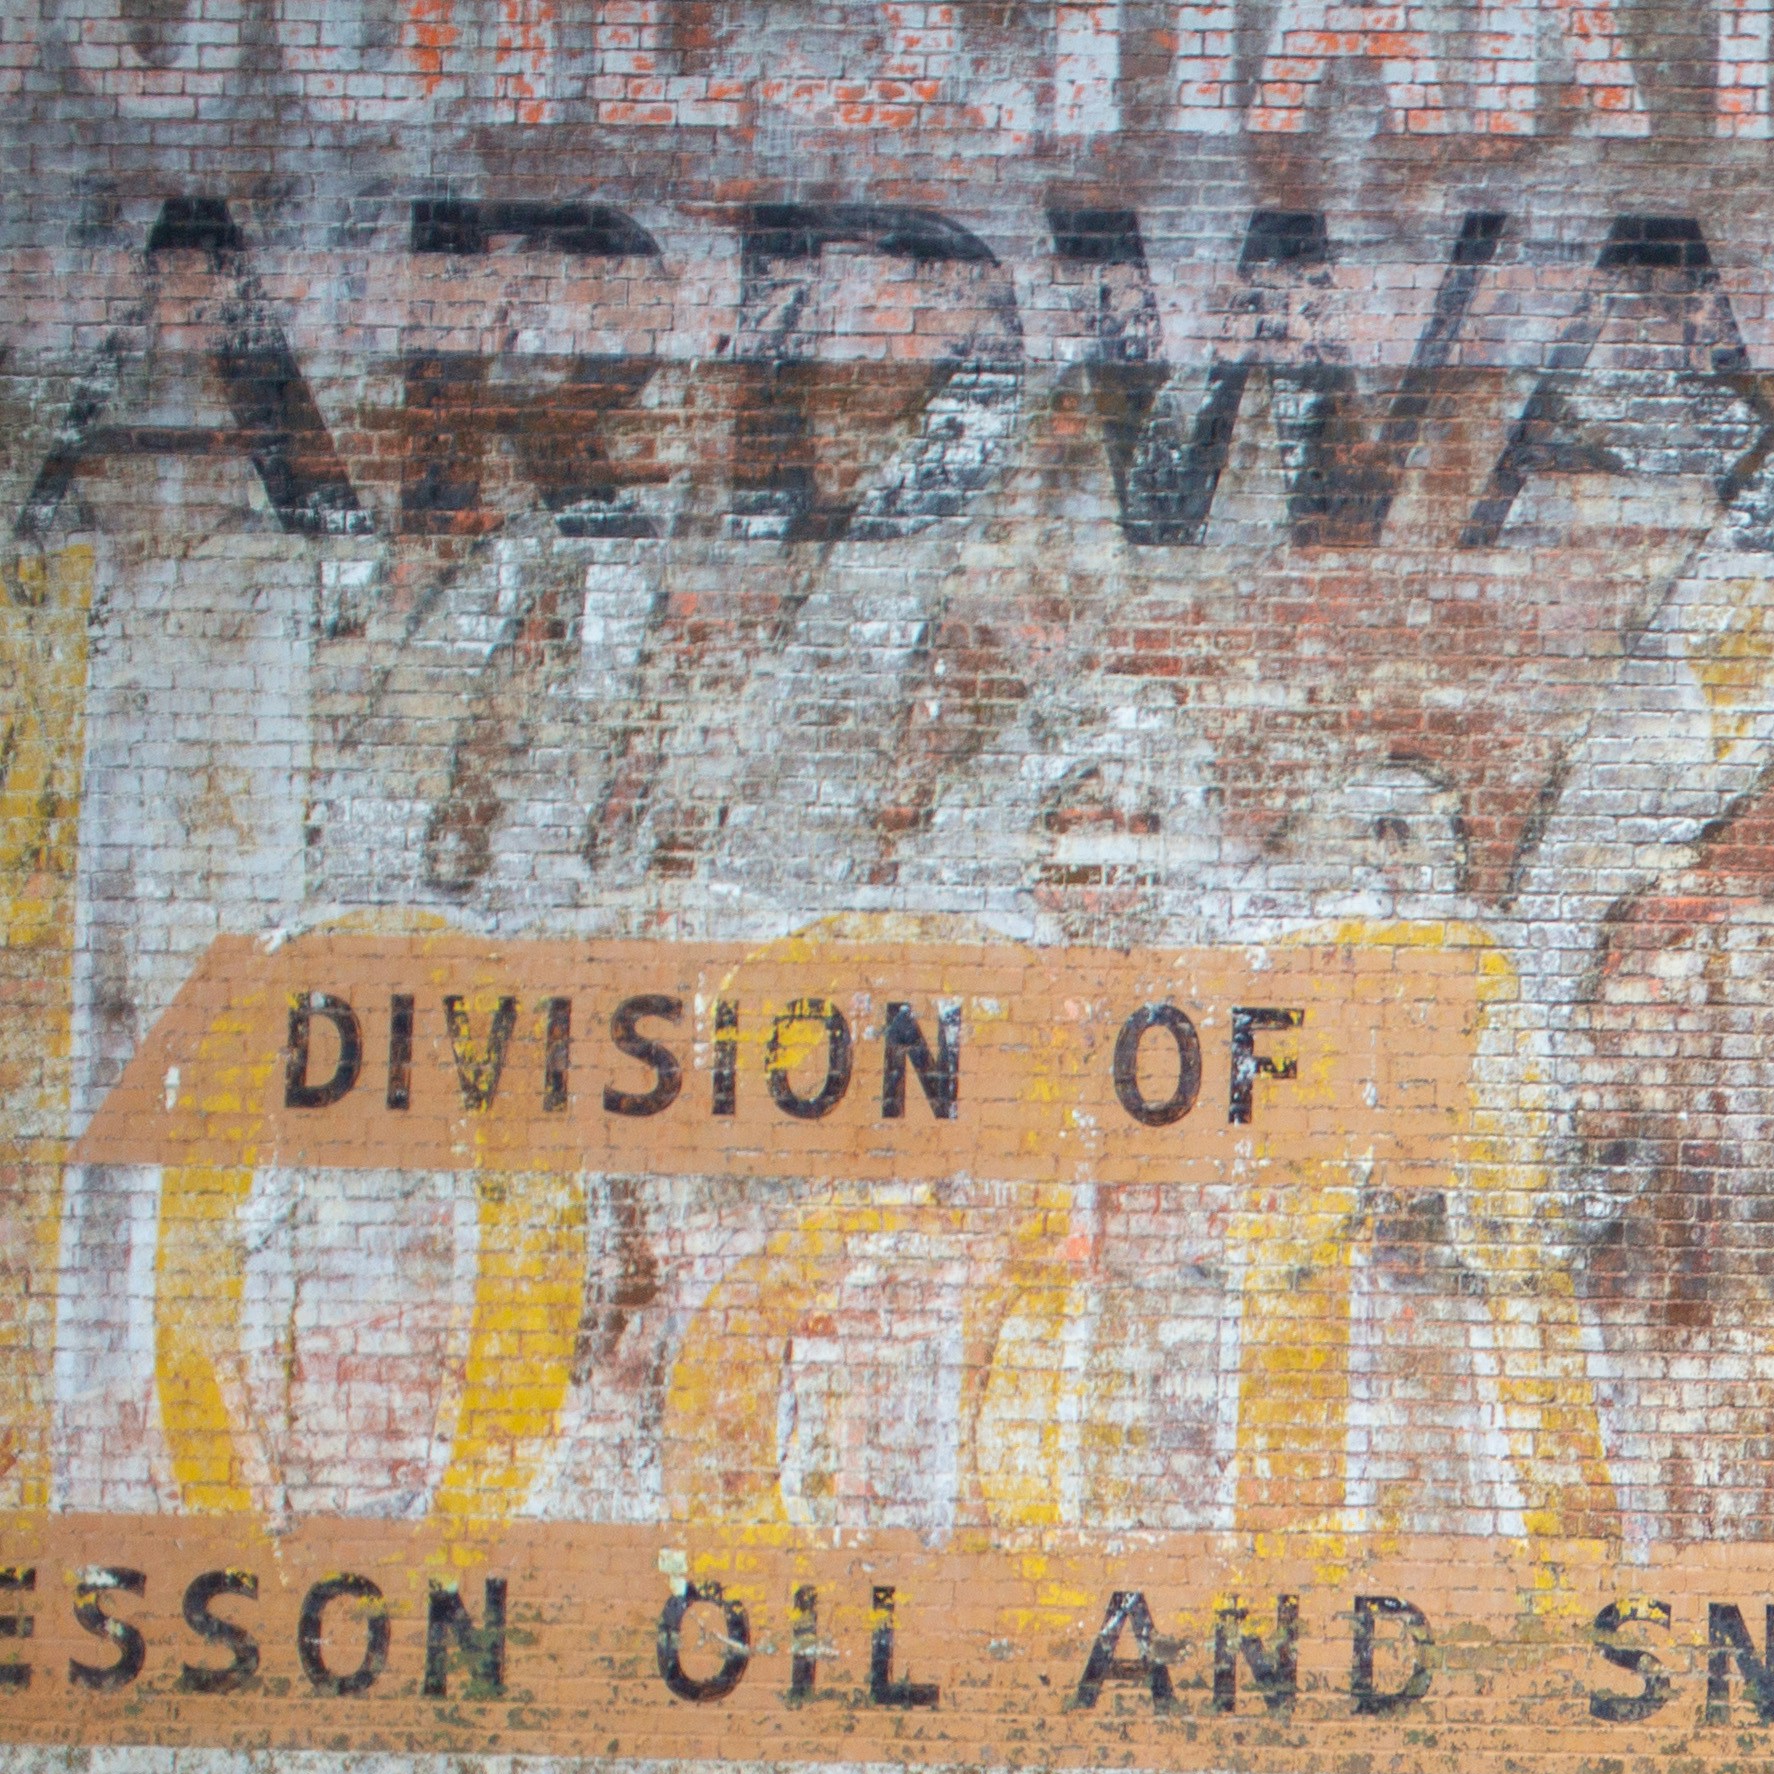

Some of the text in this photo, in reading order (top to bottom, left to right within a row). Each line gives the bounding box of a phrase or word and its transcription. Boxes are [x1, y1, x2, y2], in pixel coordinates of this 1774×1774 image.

[284, 990, 1306, 1128] DIVISION OF
[657, 1582, 940, 1707] OIL
[1077, 1590, 1432, 1717] AND
